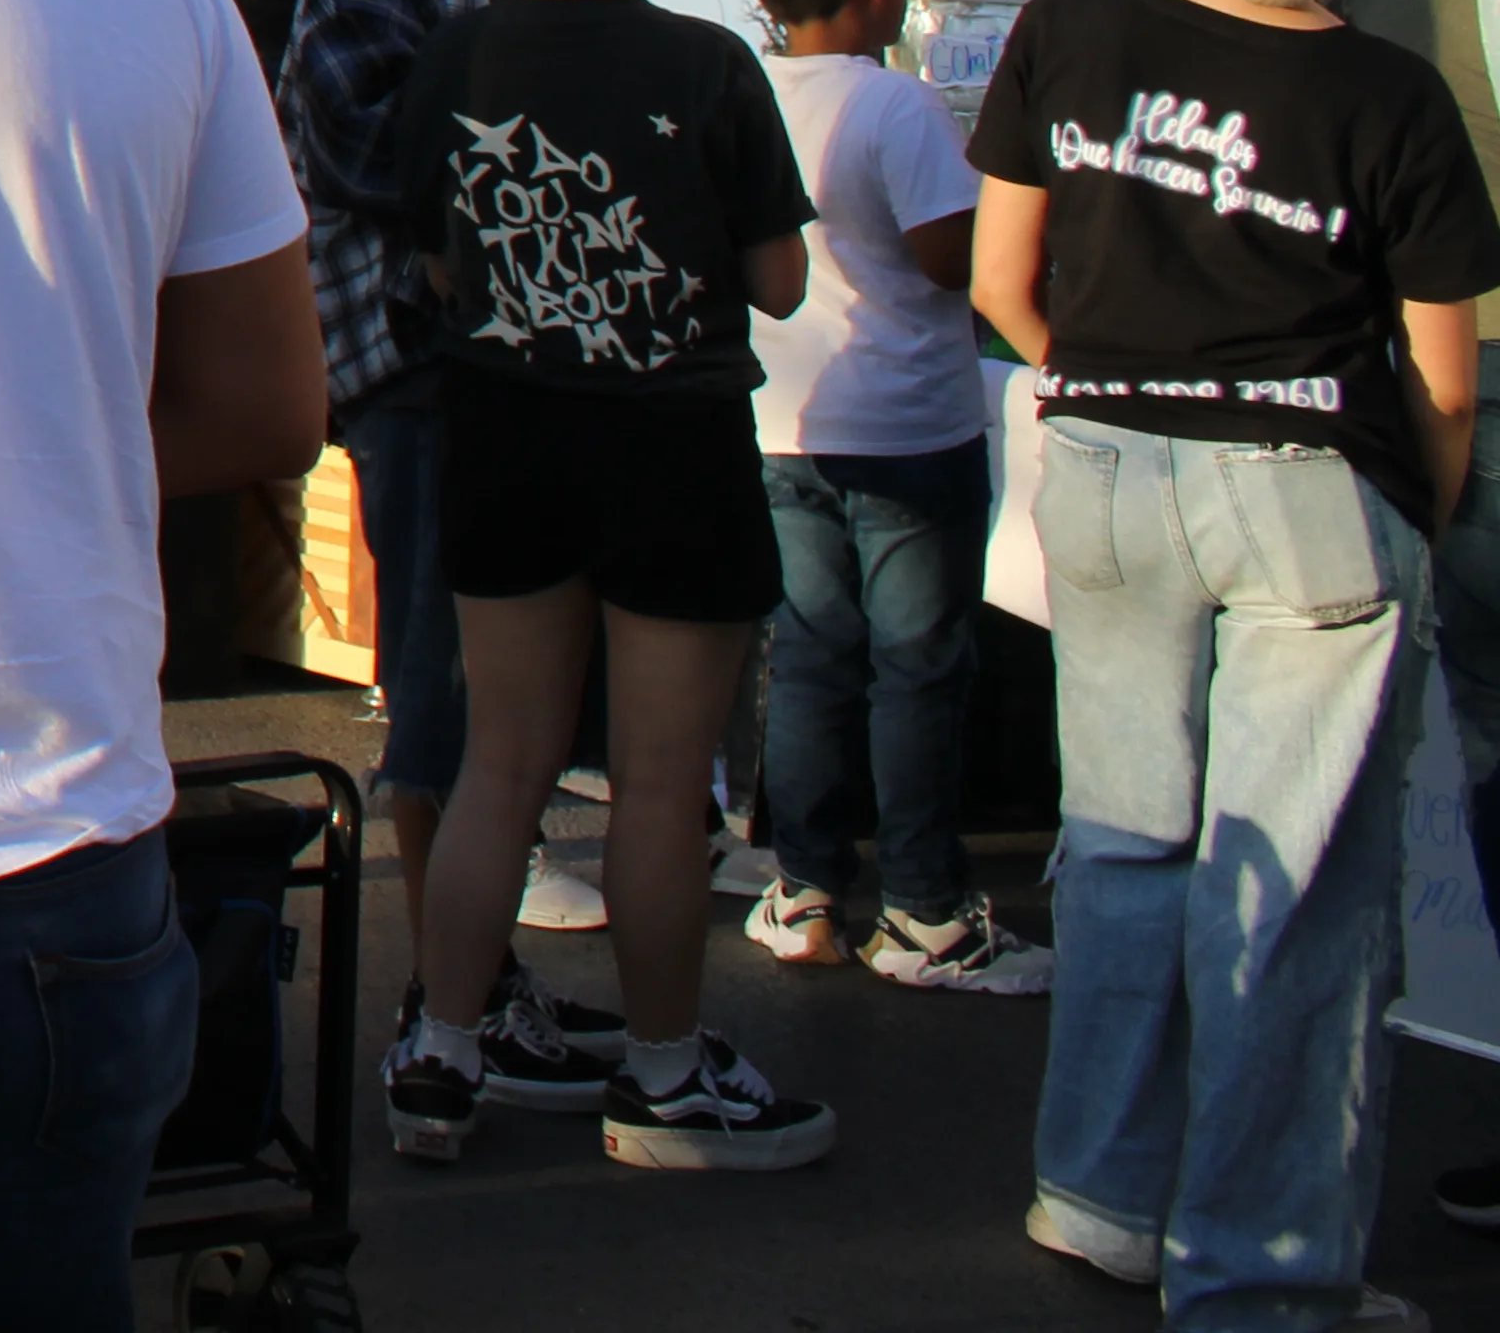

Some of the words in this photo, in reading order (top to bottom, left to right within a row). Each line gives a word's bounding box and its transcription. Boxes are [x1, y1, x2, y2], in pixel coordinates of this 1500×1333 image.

[529, 122, 613, 193] DO
[1112, 134, 1209, 195] hacen
[1127, 90, 1259, 171] Helados
[447, 150, 570, 225] YOU
